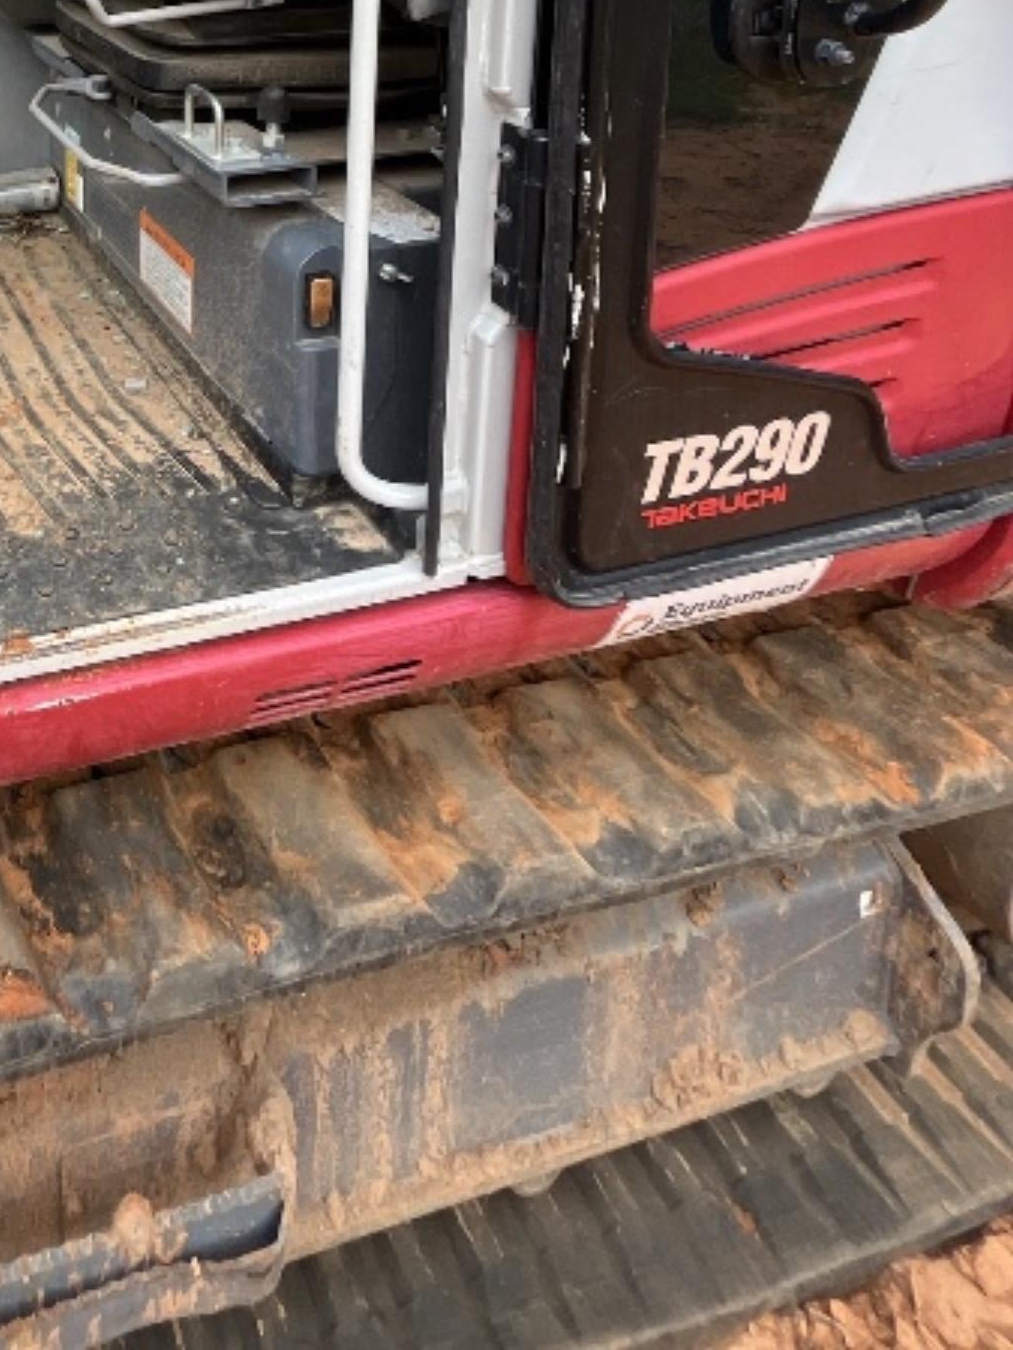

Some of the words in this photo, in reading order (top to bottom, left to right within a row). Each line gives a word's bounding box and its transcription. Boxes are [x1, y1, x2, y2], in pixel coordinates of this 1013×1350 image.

[641, 410, 831, 505] TB290
[641, 484, 788, 529] TAKEUCHI
[663, 578, 809, 619] Equipment
